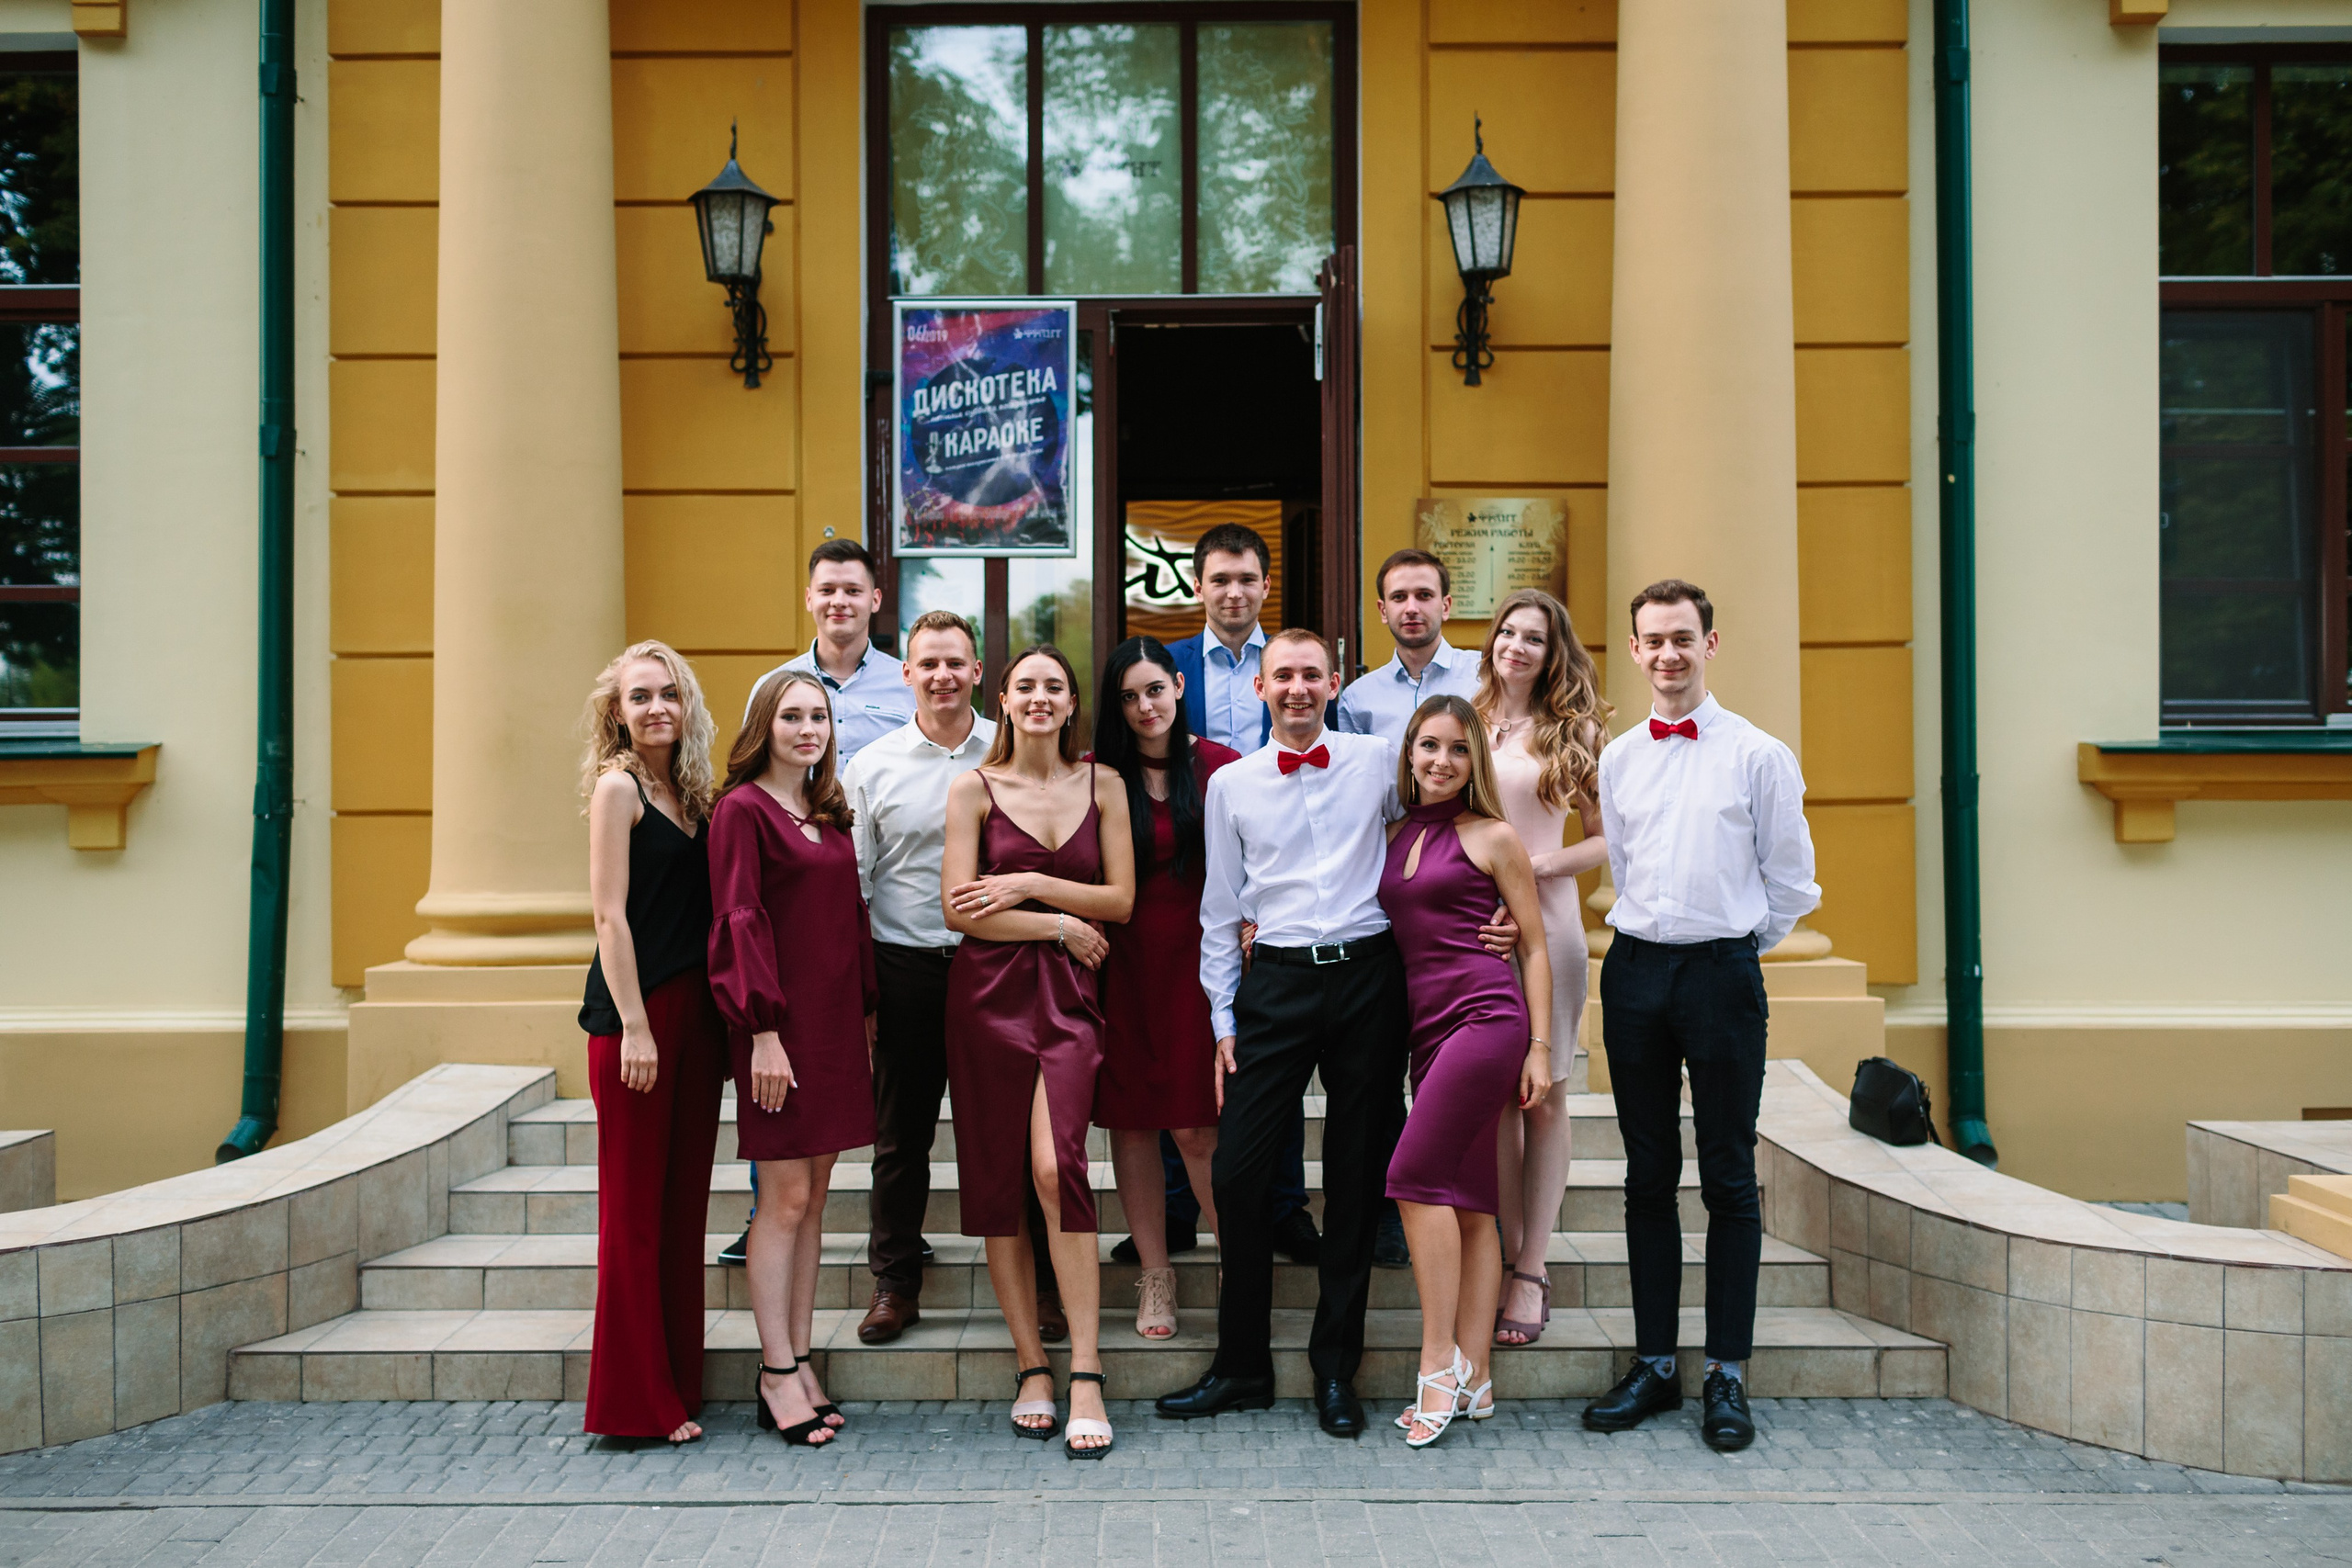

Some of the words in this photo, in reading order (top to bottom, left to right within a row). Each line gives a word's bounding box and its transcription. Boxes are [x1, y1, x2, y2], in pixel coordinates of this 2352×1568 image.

[912, 367, 1057, 418] ДИСКОТЕКА
[944, 417, 1044, 458] КАРАОКЕ
[1451, 528, 1488, 537] РЕЖИМ
[1490, 528, 1533, 537] РАБОТЫ
